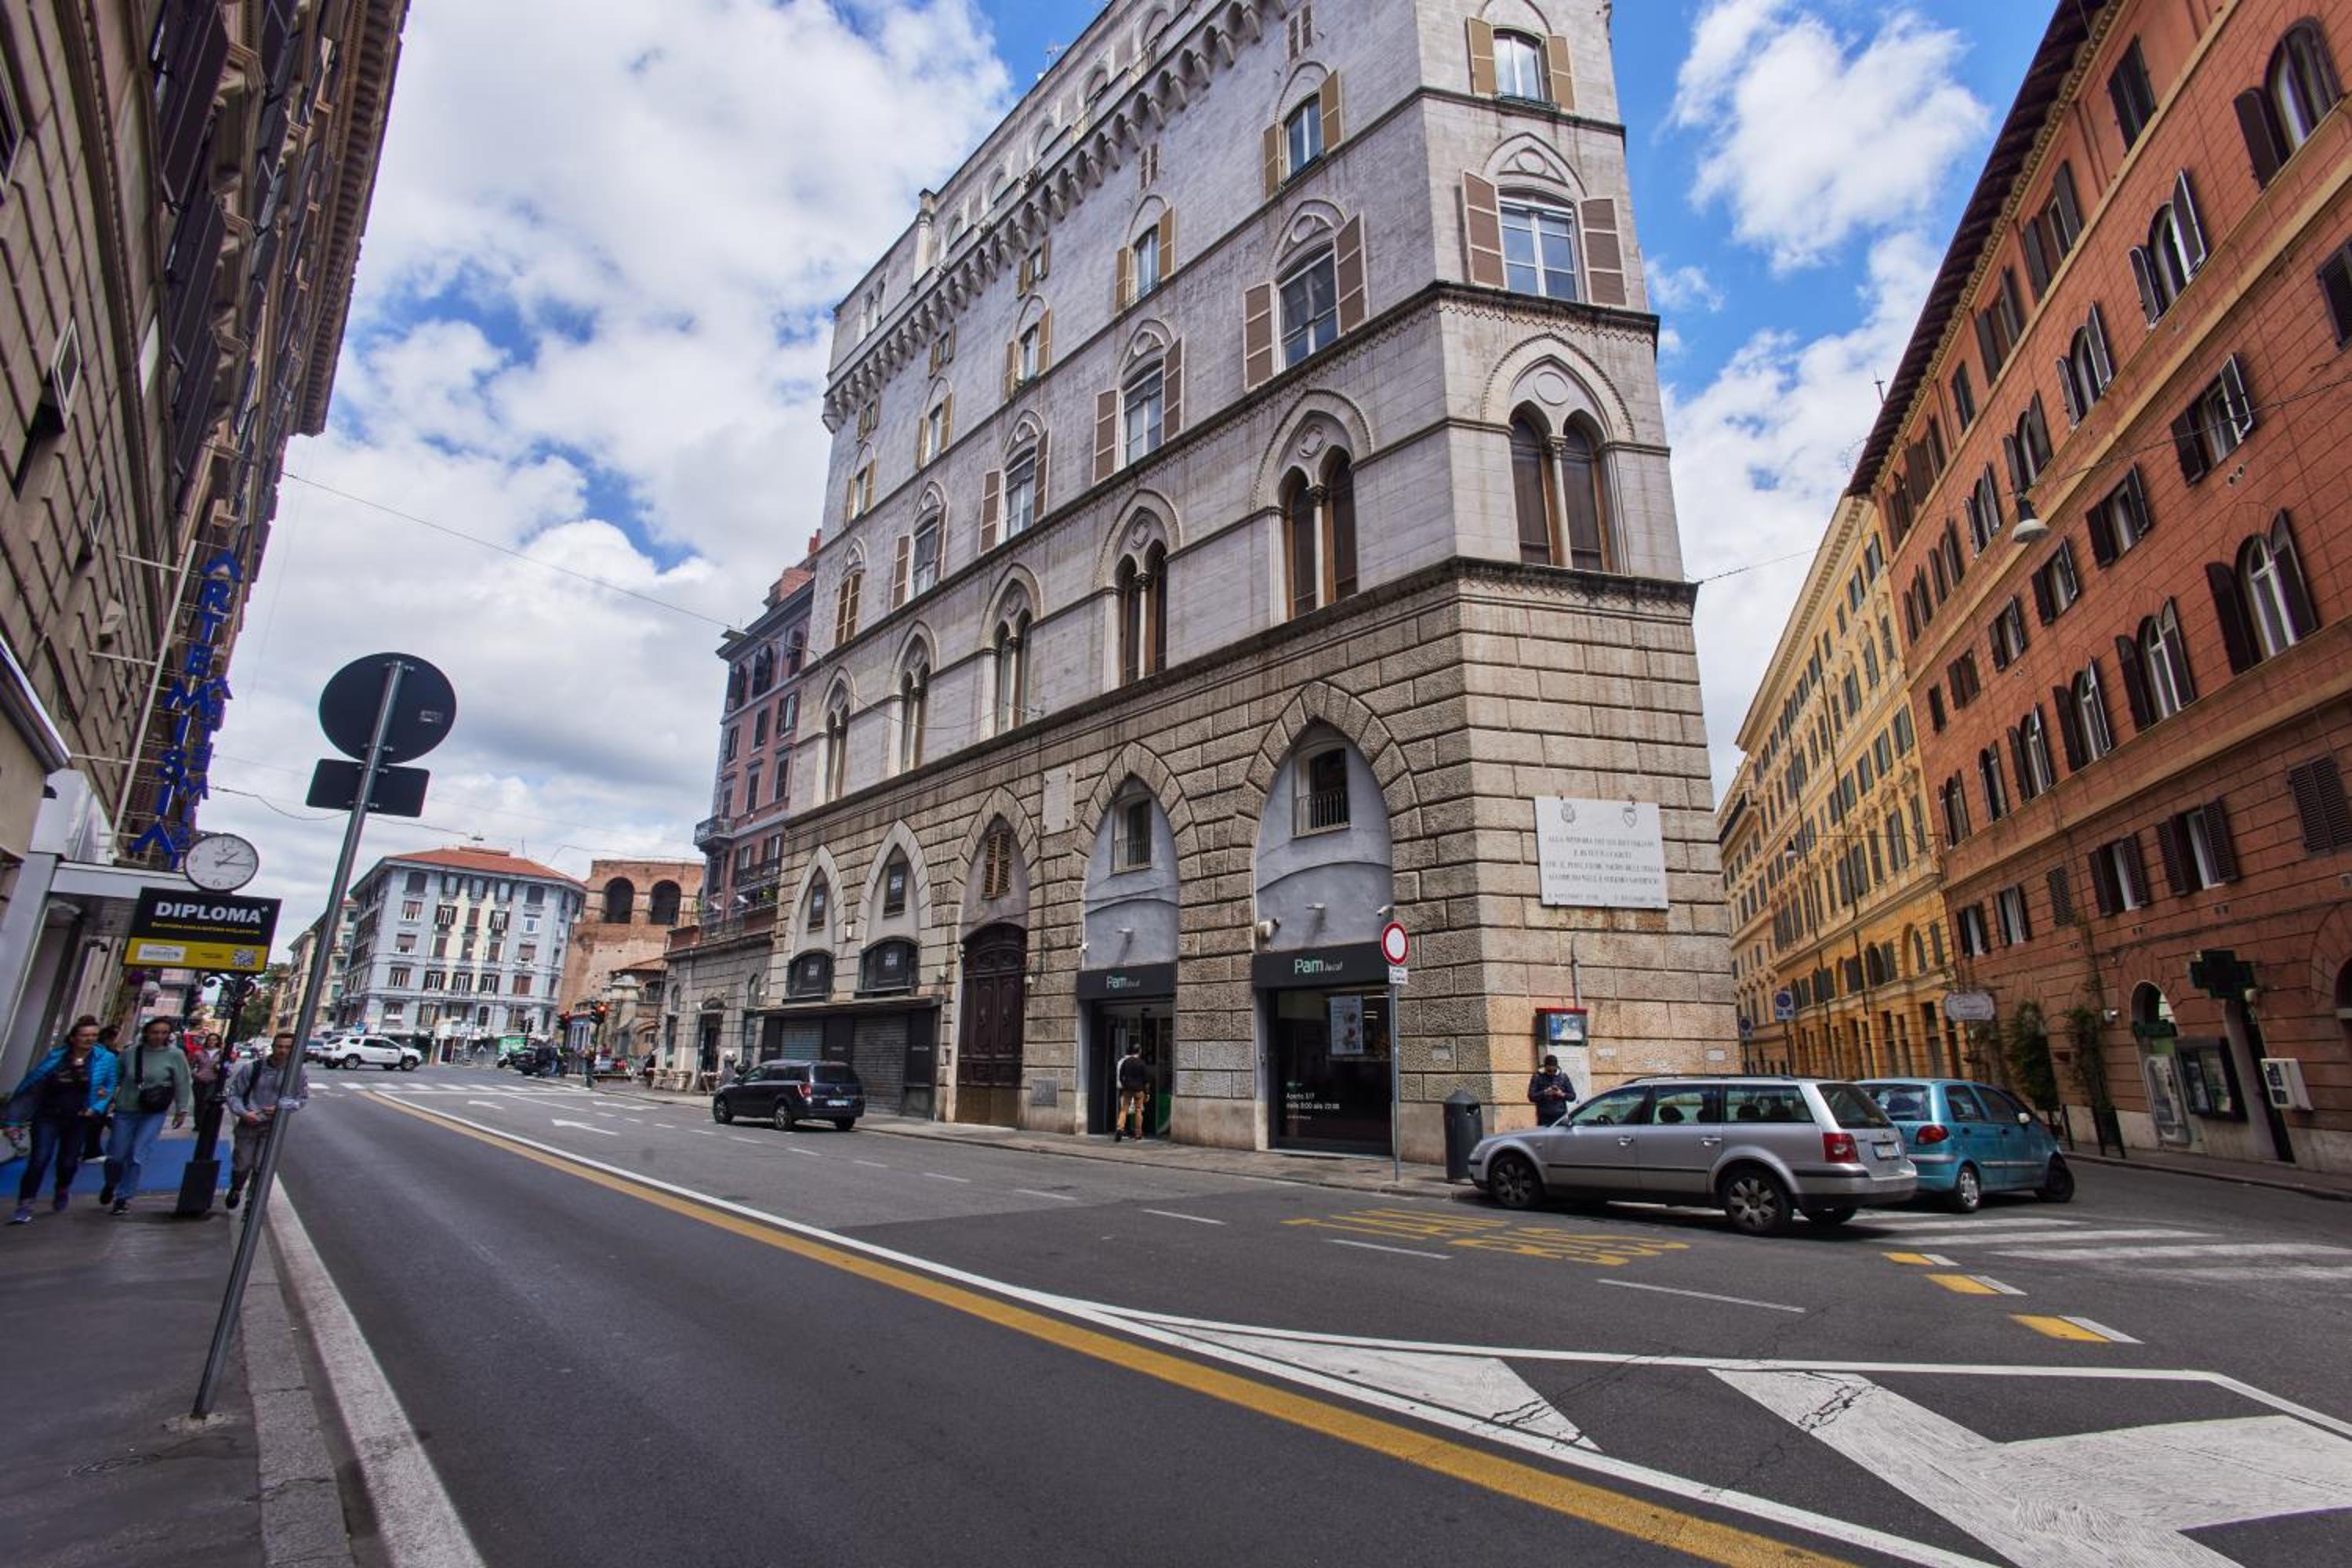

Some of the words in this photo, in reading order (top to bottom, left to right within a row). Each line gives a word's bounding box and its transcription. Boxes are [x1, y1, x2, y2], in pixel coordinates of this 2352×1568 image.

[131, 549, 242, 853] ARTEMISIA
[154, 902, 261, 924] DIPLOMA
[1294, 958, 1323, 975] Pam
[1105, 975, 1127, 989] Pam
[1447, 1227, 1691, 1266] BUS
